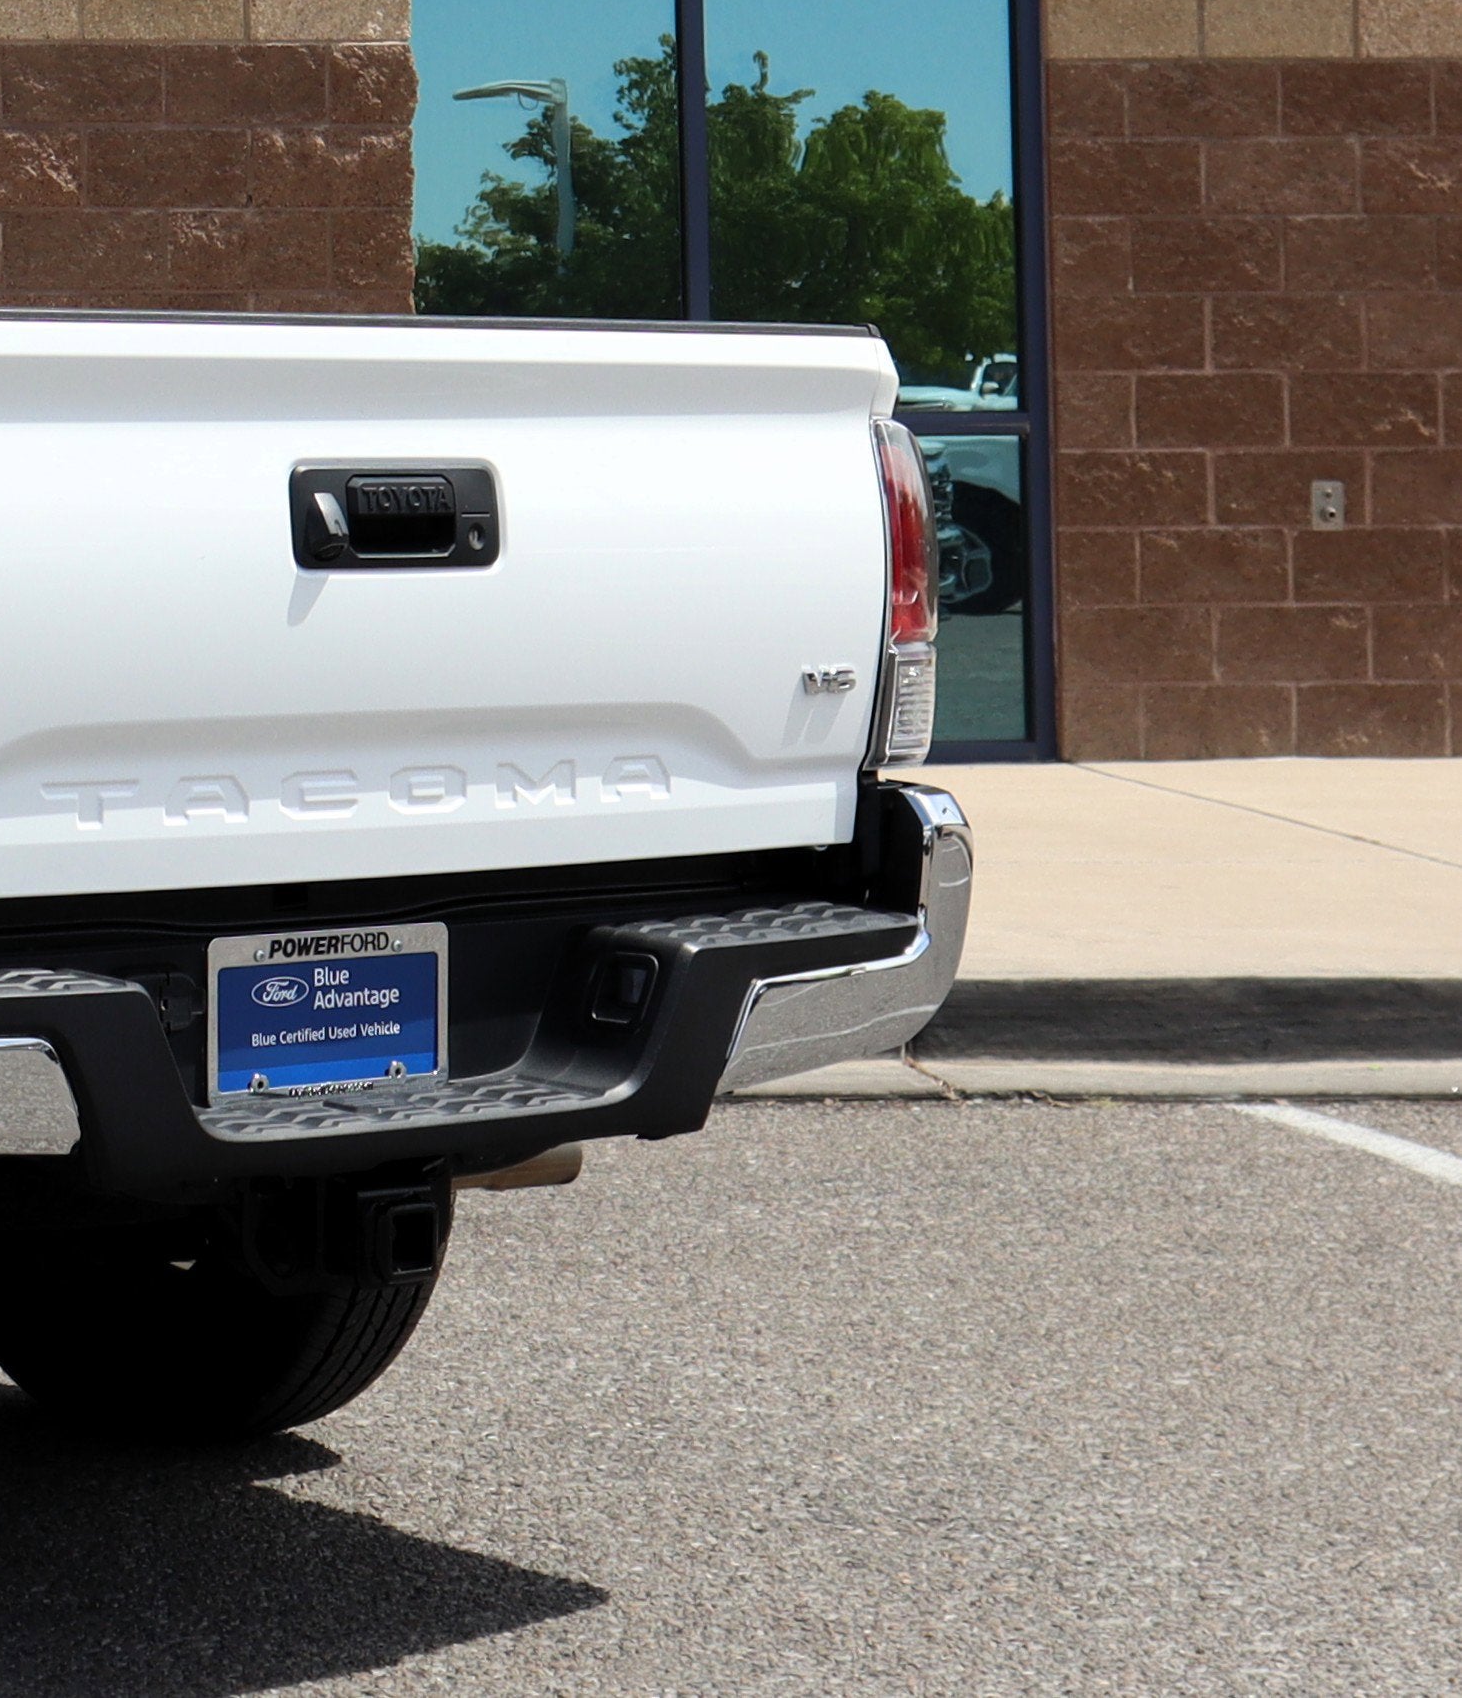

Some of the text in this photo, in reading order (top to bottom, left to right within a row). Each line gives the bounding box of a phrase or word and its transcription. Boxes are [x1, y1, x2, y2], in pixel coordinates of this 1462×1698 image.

[362, 486, 452, 511] TOYOTA
[801, 664, 857, 695] V6
[39, 754, 673, 833] TACOMA
[268, 931, 390, 960] POWERFORD
[313, 967, 350, 988] Blue
[262, 981, 299, 1003] Ford
[313, 986, 400, 1011] Advantage
[251, 1020, 401, 1047] Blue Certified Used Vehicle
